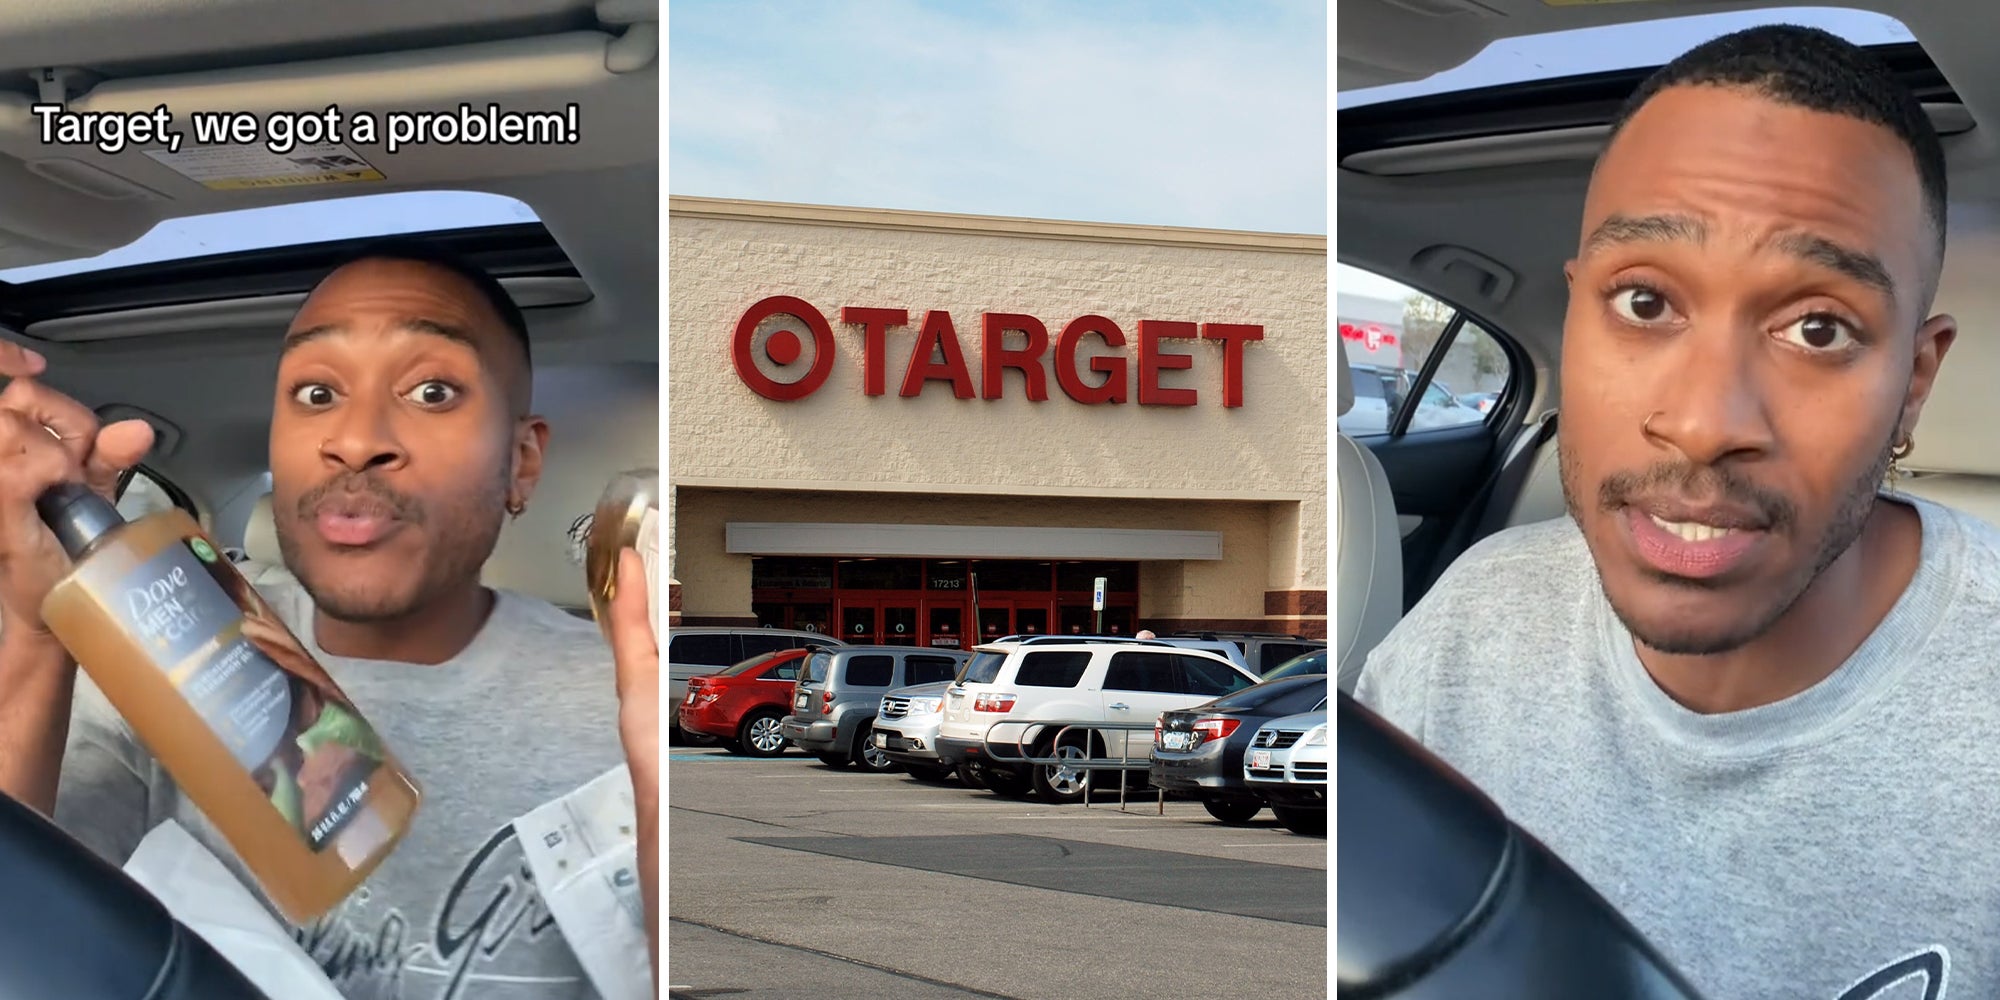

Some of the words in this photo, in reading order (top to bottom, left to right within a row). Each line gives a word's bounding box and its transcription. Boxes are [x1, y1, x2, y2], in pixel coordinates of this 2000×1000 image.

[841, 306, 1264, 408] TARGET
[127, 566, 188, 620] Dove
[933, 579, 960, 590] 17213
[138, 597, 184, 638] MEN
